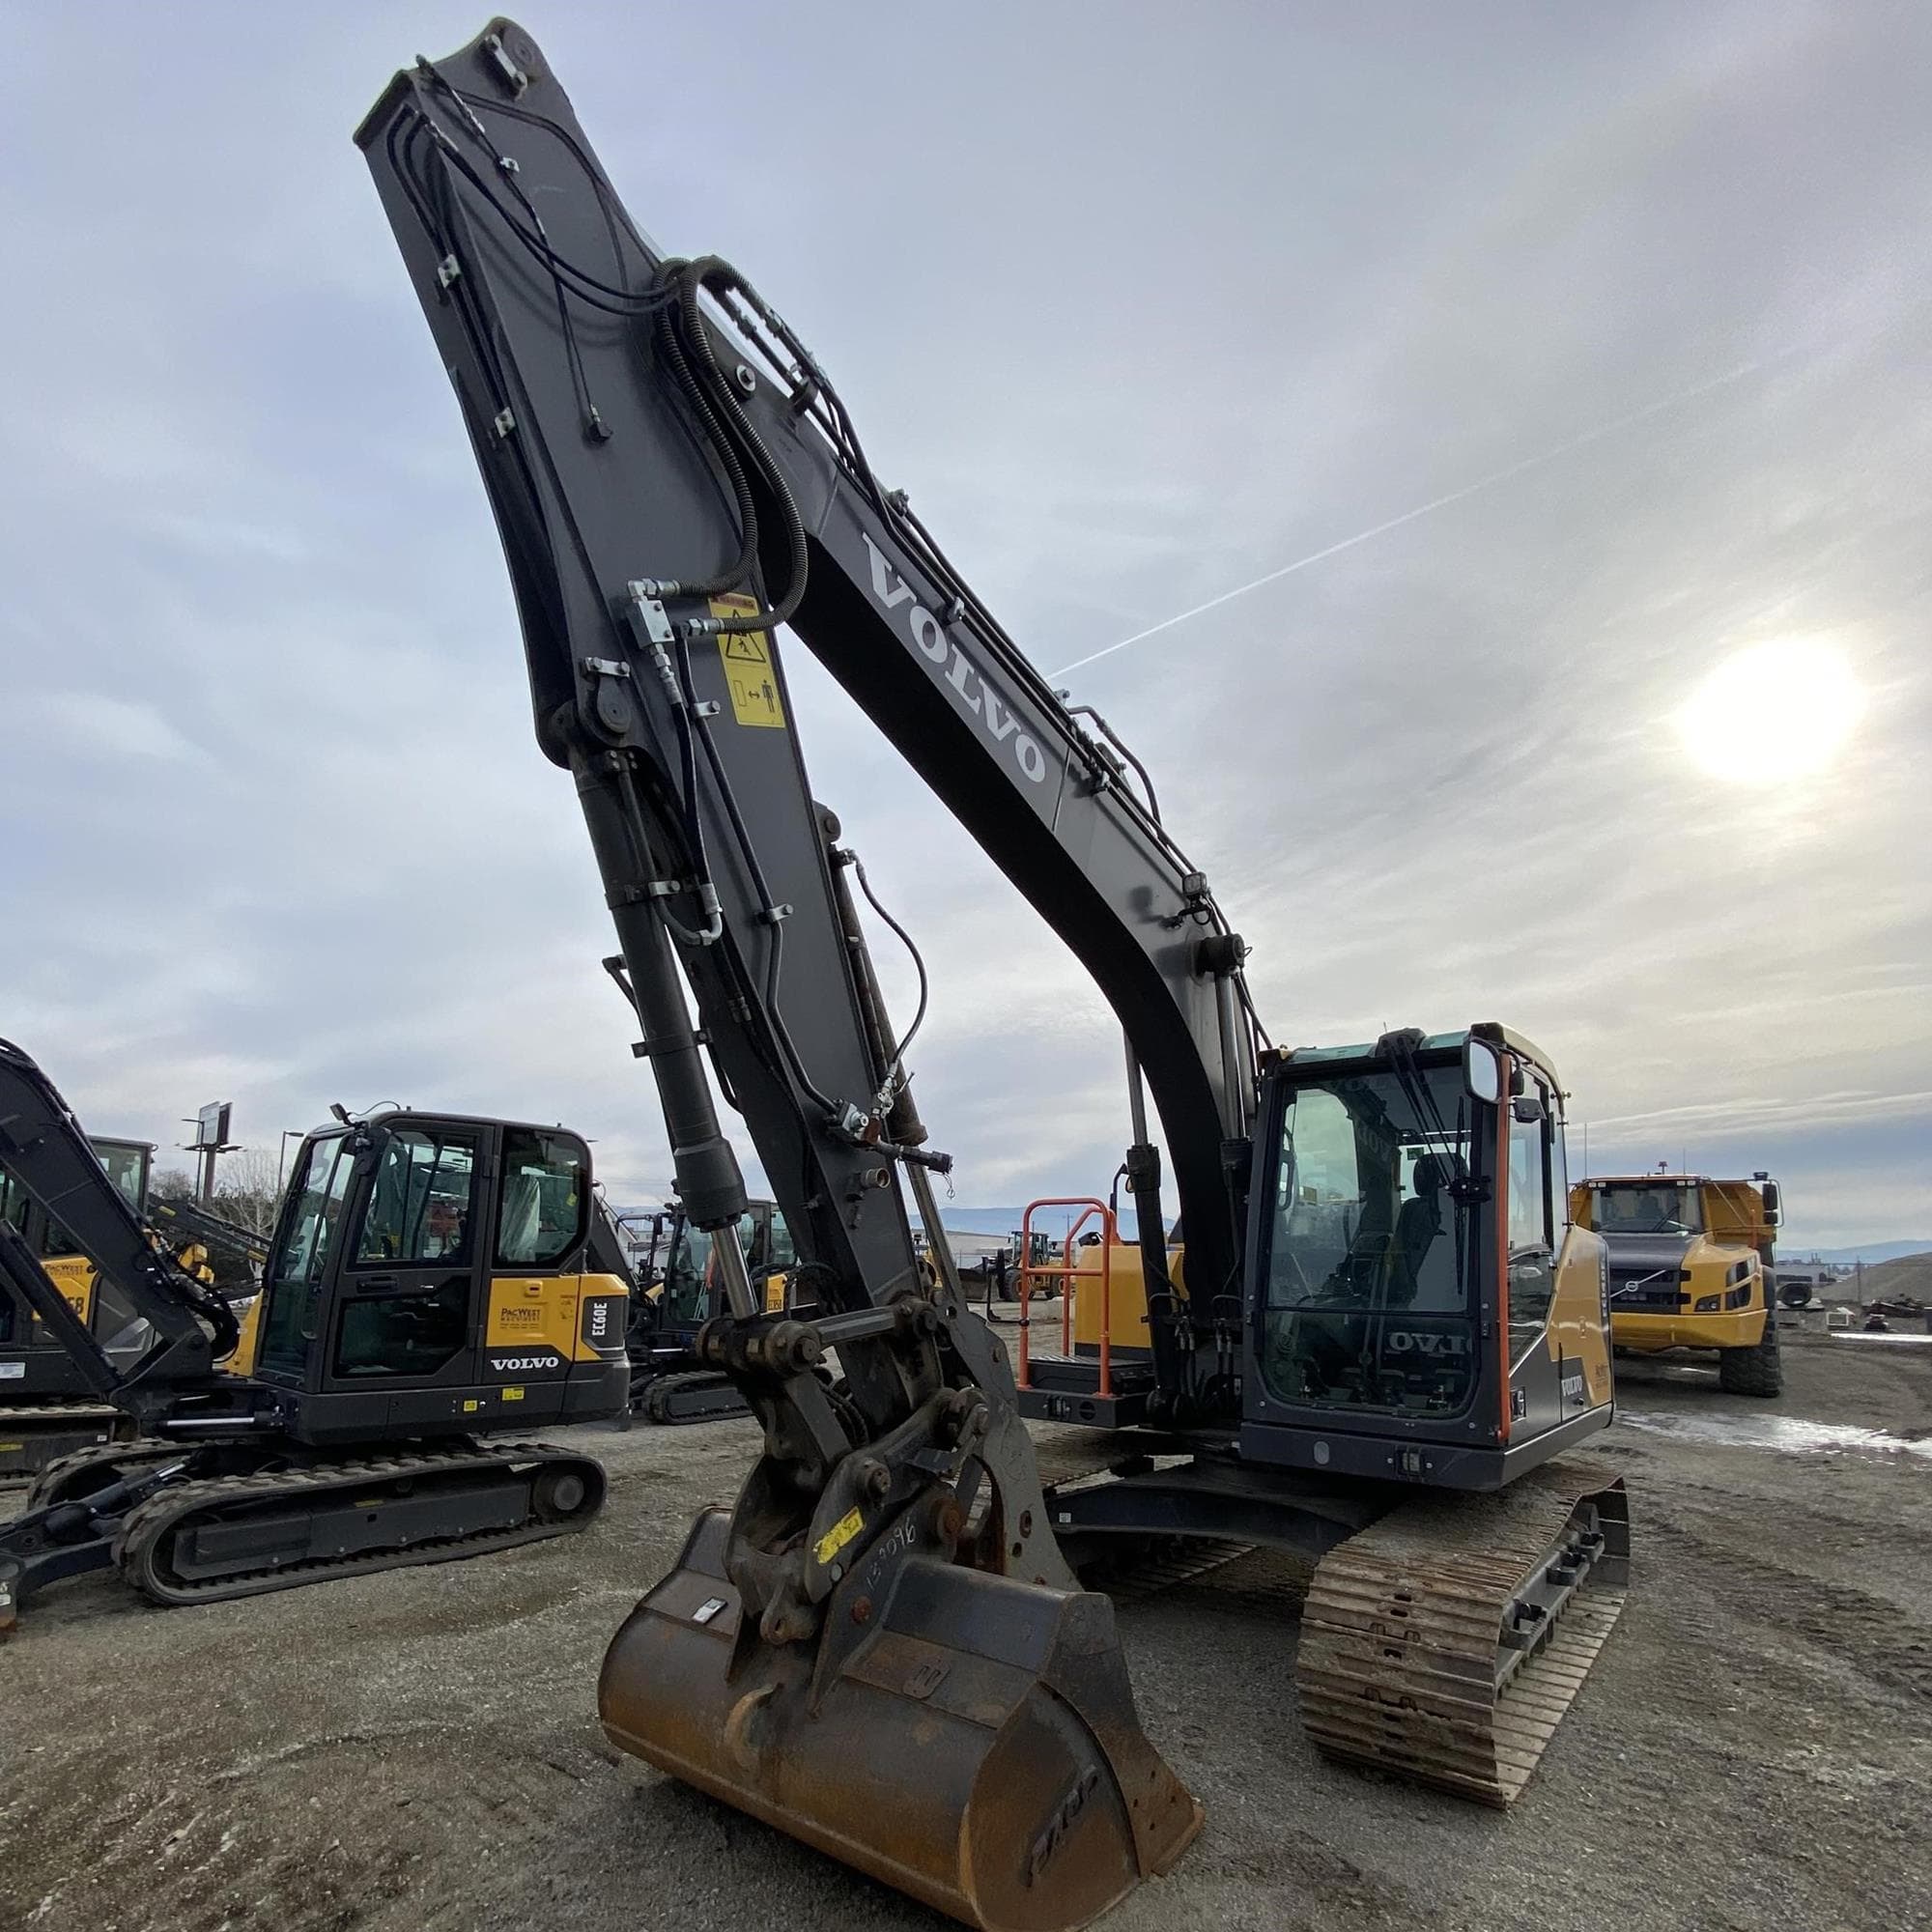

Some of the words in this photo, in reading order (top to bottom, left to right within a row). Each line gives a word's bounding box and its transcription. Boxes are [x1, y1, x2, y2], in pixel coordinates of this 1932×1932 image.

[863, 532, 1045, 782] VOLVO
[591, 1302, 608, 1336] EC60E
[491, 1357, 559, 1371] VOLVO
